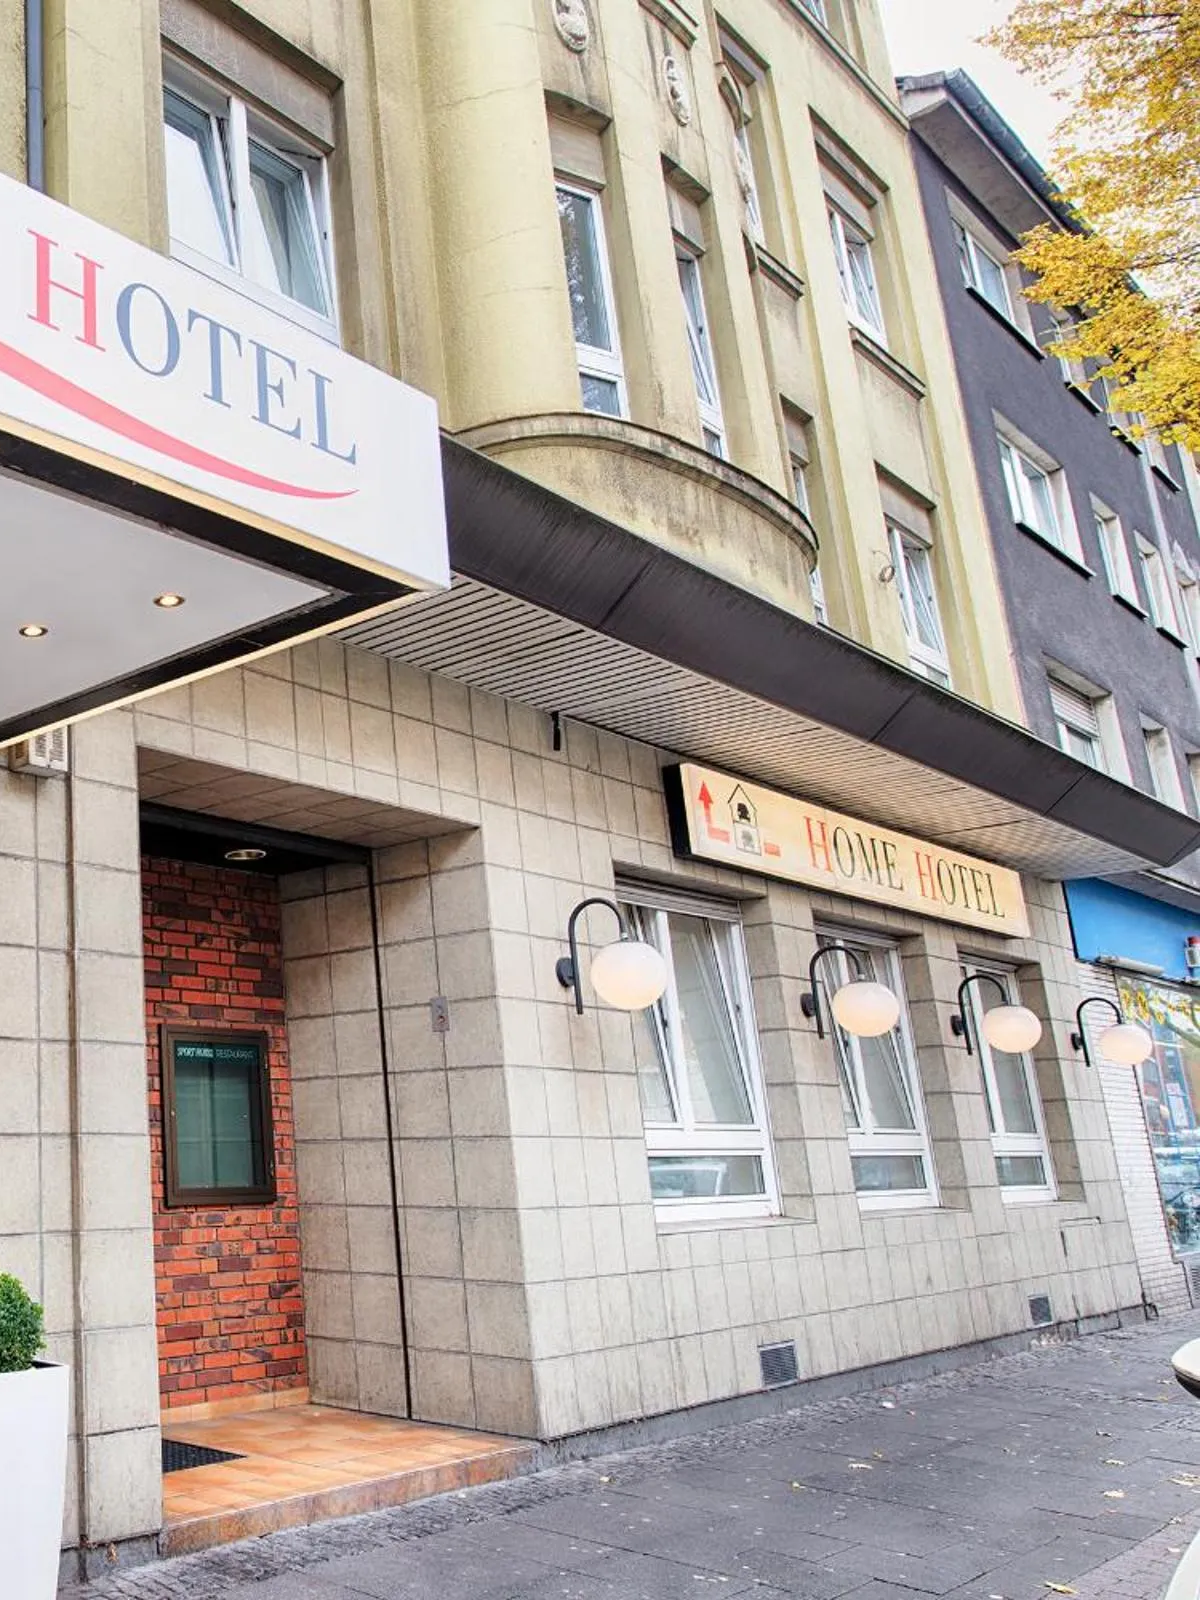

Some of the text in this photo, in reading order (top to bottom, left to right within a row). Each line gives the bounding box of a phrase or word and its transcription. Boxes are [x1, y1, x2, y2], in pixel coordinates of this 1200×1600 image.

[28, 228, 356, 465] HOTEL
[803, 815, 1005, 918] HOME HOTEL
